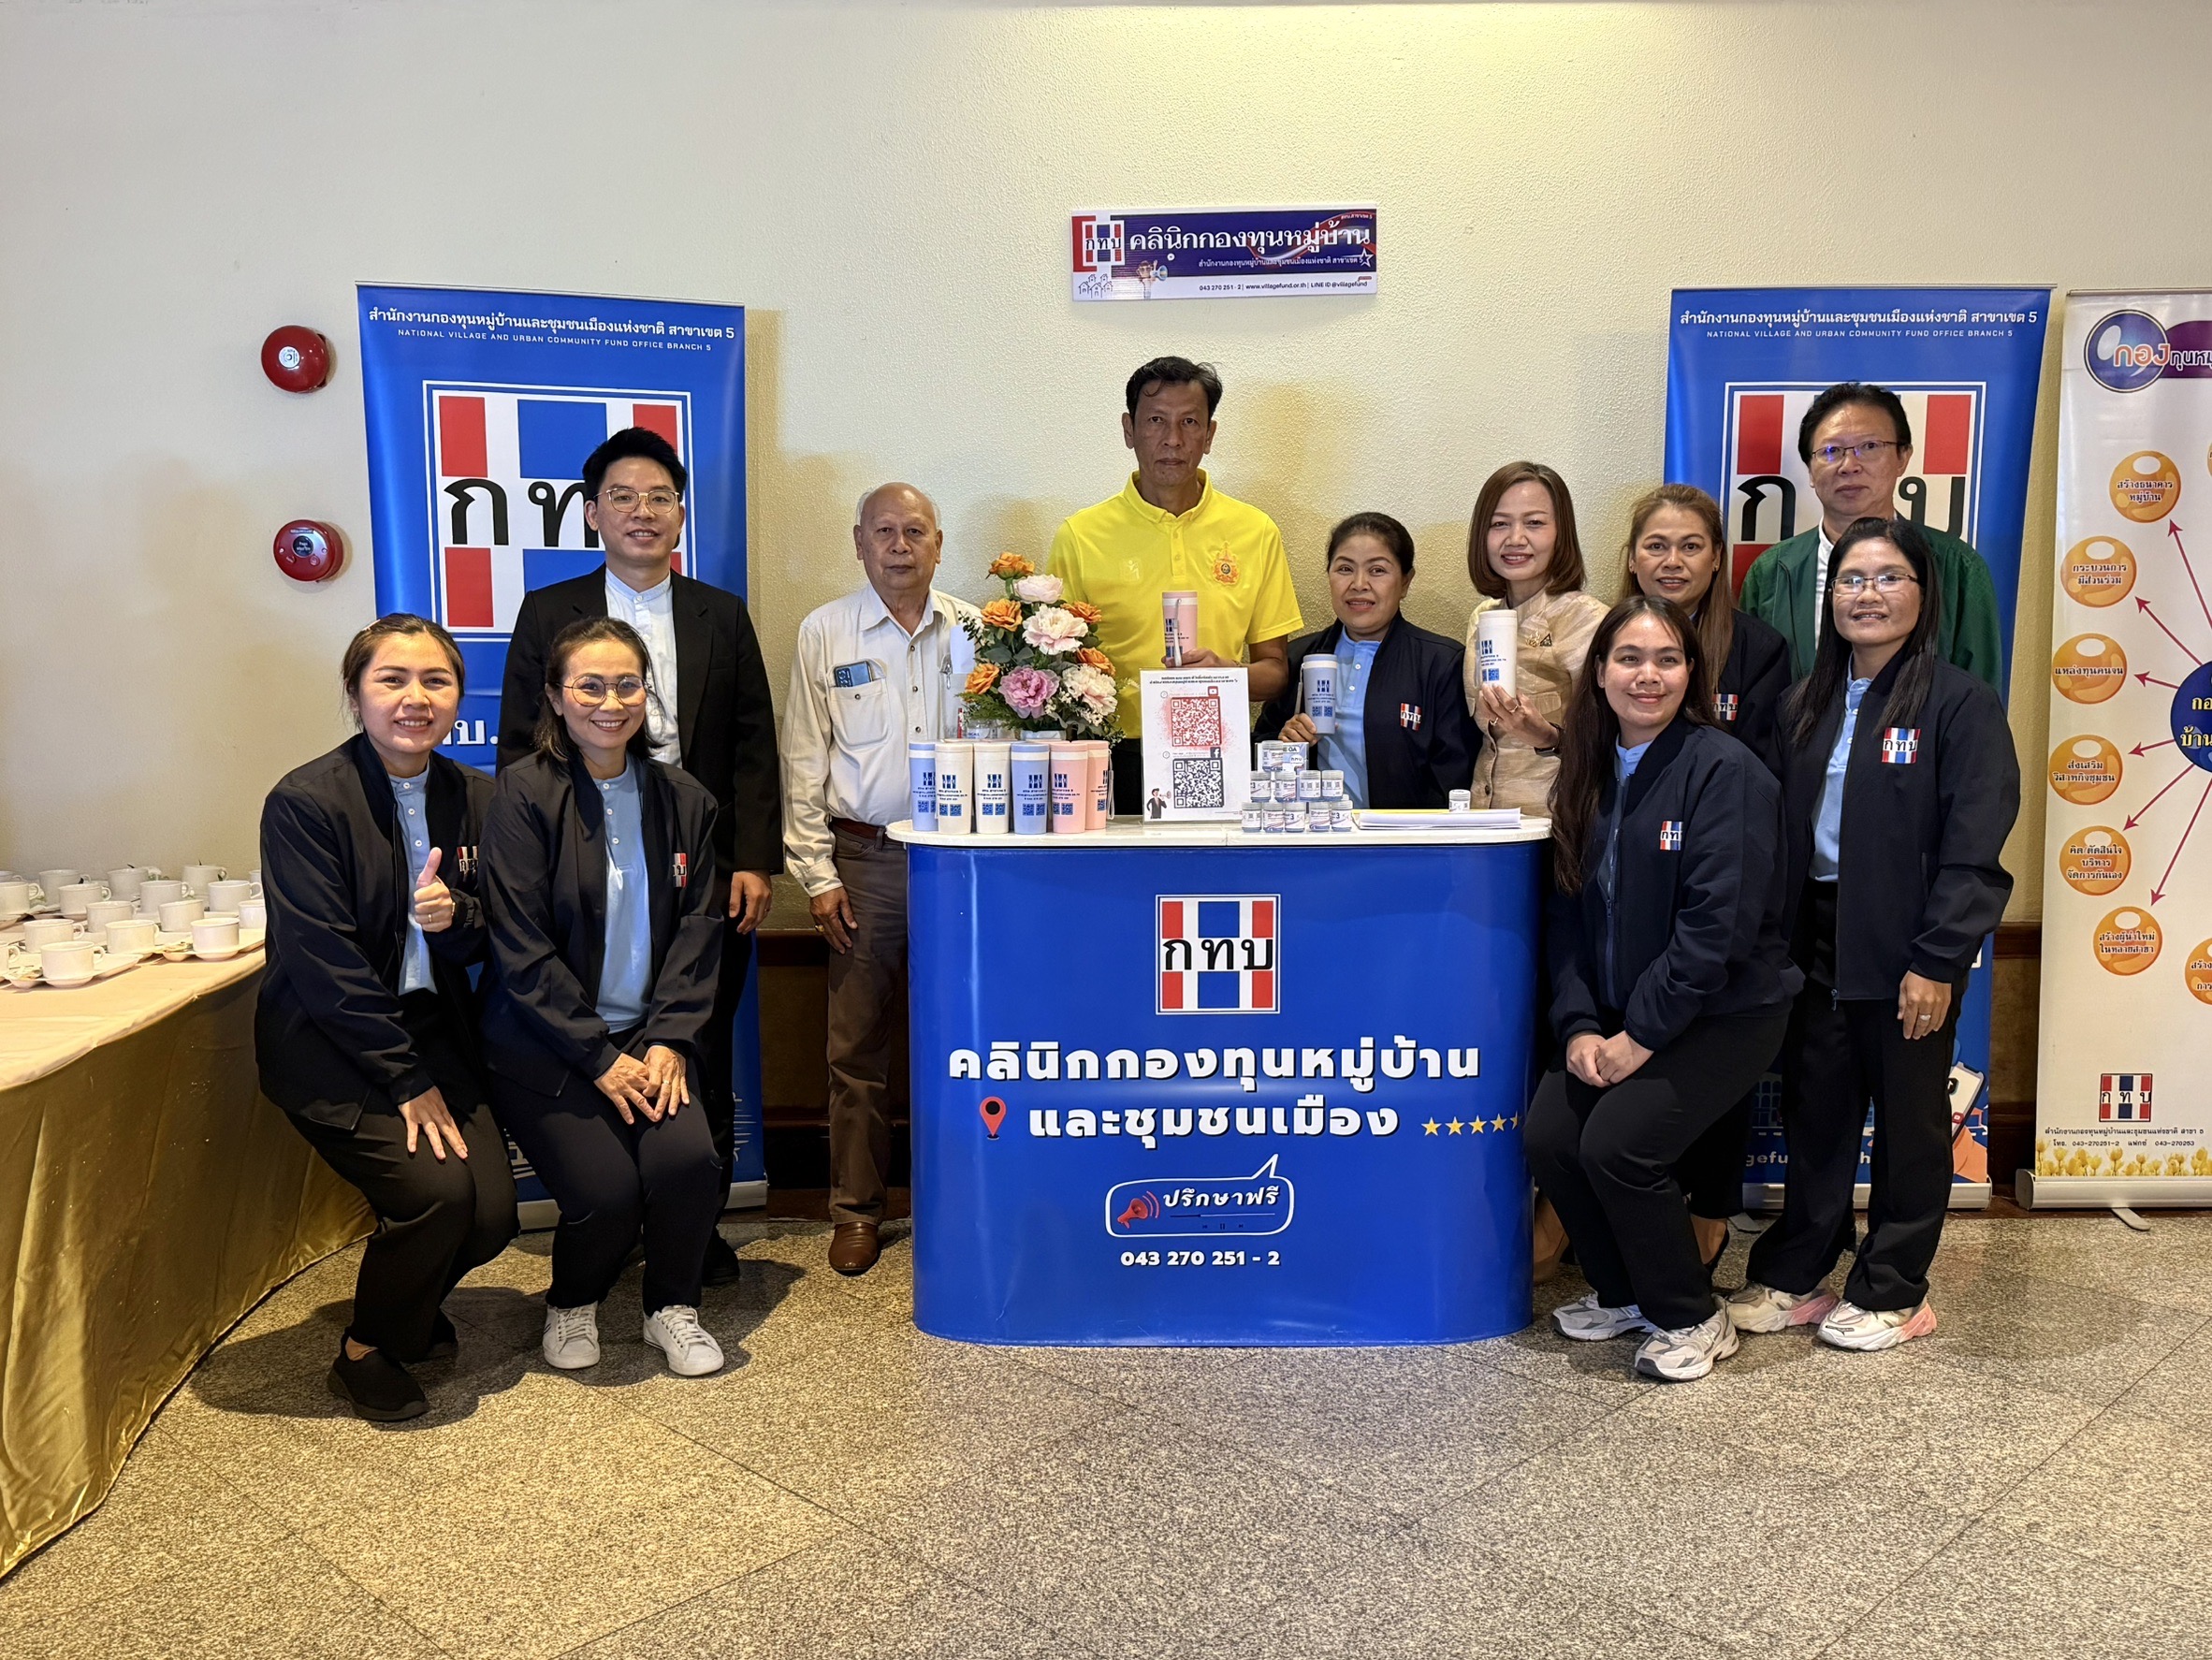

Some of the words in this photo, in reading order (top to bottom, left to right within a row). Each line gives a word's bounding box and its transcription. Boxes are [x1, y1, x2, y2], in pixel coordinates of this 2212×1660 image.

[1085, 235, 1121, 251] กทบ
[1129, 220, 1371, 255] คลินิกกองทุนหมู่บ้าน
[369, 307, 665, 336] สำนักงานกองทุนหมู่บ้านและชุมชนเมืองแห่งชาติ
[668, 325, 722, 338] สาขาเขต
[725, 327, 735, 339] 5
[1680, 308, 1967, 328] สำนักงานกองทุนหมู่บ้านและชุมชนเมืองแห่งชาติ
[1971, 313, 2025, 324] สาขาเขต
[2028, 311, 2038, 323] 5
[398, 328, 444, 338] NATIONAL
[448, 331, 487, 340] VILLAGE
[513, 335, 544, 343] URBAN
[547, 337, 602, 345] COMMUNITY
[632, 341, 664, 349] OFFICE
[667, 342, 702, 351] BRANCH
[2117, 479, 2173, 488] สร้างธนาคาร
[2130, 491, 2161, 503] หมู่บ้าน
[444, 478, 599, 547] กท
[1738, 474, 1967, 541] กบ
[2078, 575, 2121, 584] มีส่วนร่วม
[1884, 739, 1918, 751] กทบ
[2067, 760, 2103, 769] ส่งเสริม
[2082, 858, 2111, 866] บริหาร
[1161, 938, 1274, 971] กทบ
[948, 1035, 1480, 1093] คลินิกกองทุนหมู่บ้าน
[2102, 1091, 2151, 1103] กทบ
[1028, 1094, 1399, 1150] และชุมชนเมือง
[1162, 1185, 1280, 1209] ปรึกษาฟรี
[1120, 1251, 1160, 1267] 043
[1167, 1251, 1207, 1267] 270
[1212, 1251, 1245, 1267] 251
[1267, 1251, 1281, 1267] 2
